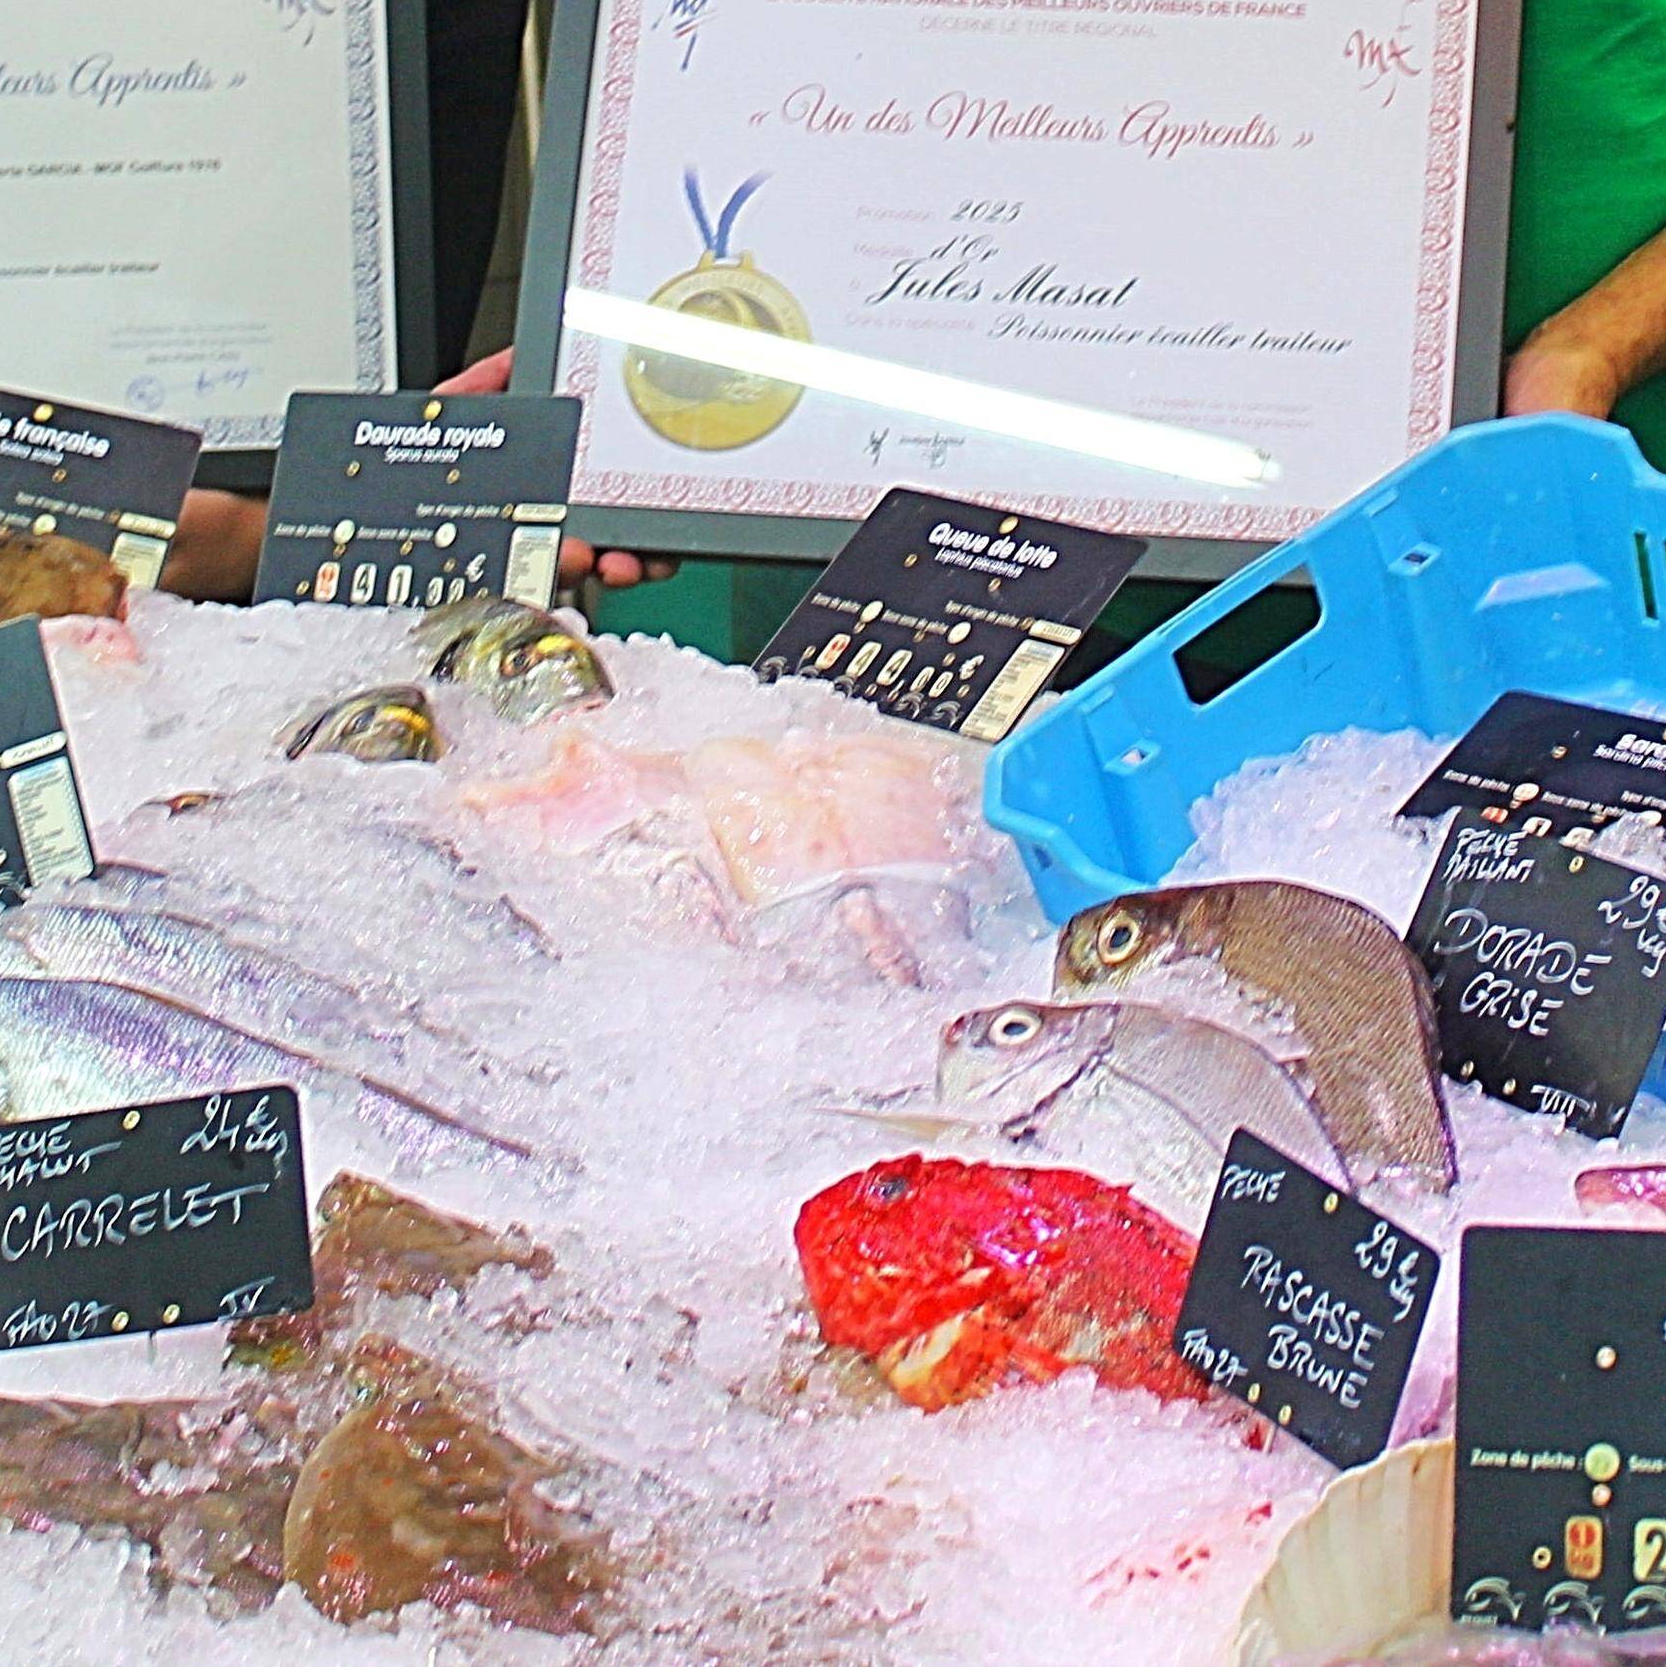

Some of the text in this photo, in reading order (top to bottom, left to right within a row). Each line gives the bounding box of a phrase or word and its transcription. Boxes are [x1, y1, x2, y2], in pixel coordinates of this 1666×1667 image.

[1207, 1, 1232, 16] DE
[1236, 1, 1308, 18] FRANCE
[68, 53, 217, 107] Apprentis
[783, 83, 1280, 160] Un des Meilleurs Apprentis
[948, 198, 1024, 224] 2025
[865, 258, 1138, 308] Jules Masat
[987, 312, 1146, 347] Poissonnier
[1249, 329, 1353, 357] traiteur
[13, 416, 111, 459] française
[354, 420, 505, 452] Daurade royale
[928, 522, 1059, 570] Queue de lotte
[1434, 908, 1612, 996] DORADE
[0, 1182, 271, 1262] CARRELET
[1241, 1245, 1385, 1371] RASCASSE
[1268, 1324, 1369, 1409] BRUNE
[1471, 1449, 1505, 1468] Zone
[1508, 1450, 1528, 1468] de
